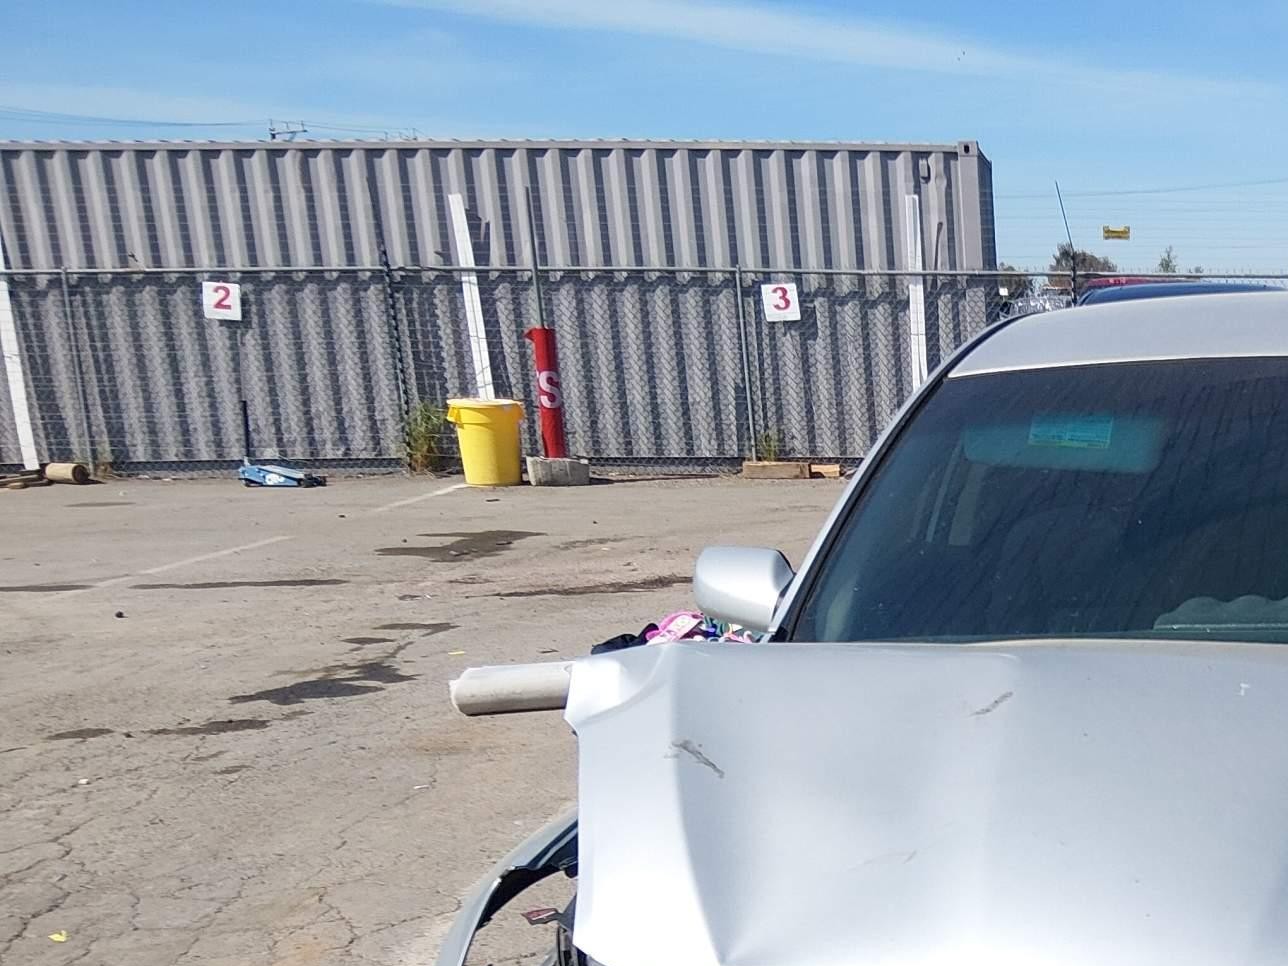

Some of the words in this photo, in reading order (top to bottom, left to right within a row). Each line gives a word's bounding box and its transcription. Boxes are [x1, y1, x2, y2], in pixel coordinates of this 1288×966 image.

[213, 285, 232, 310] 2
[771, 286, 791, 311] 3
[536, 369, 561, 409] S
